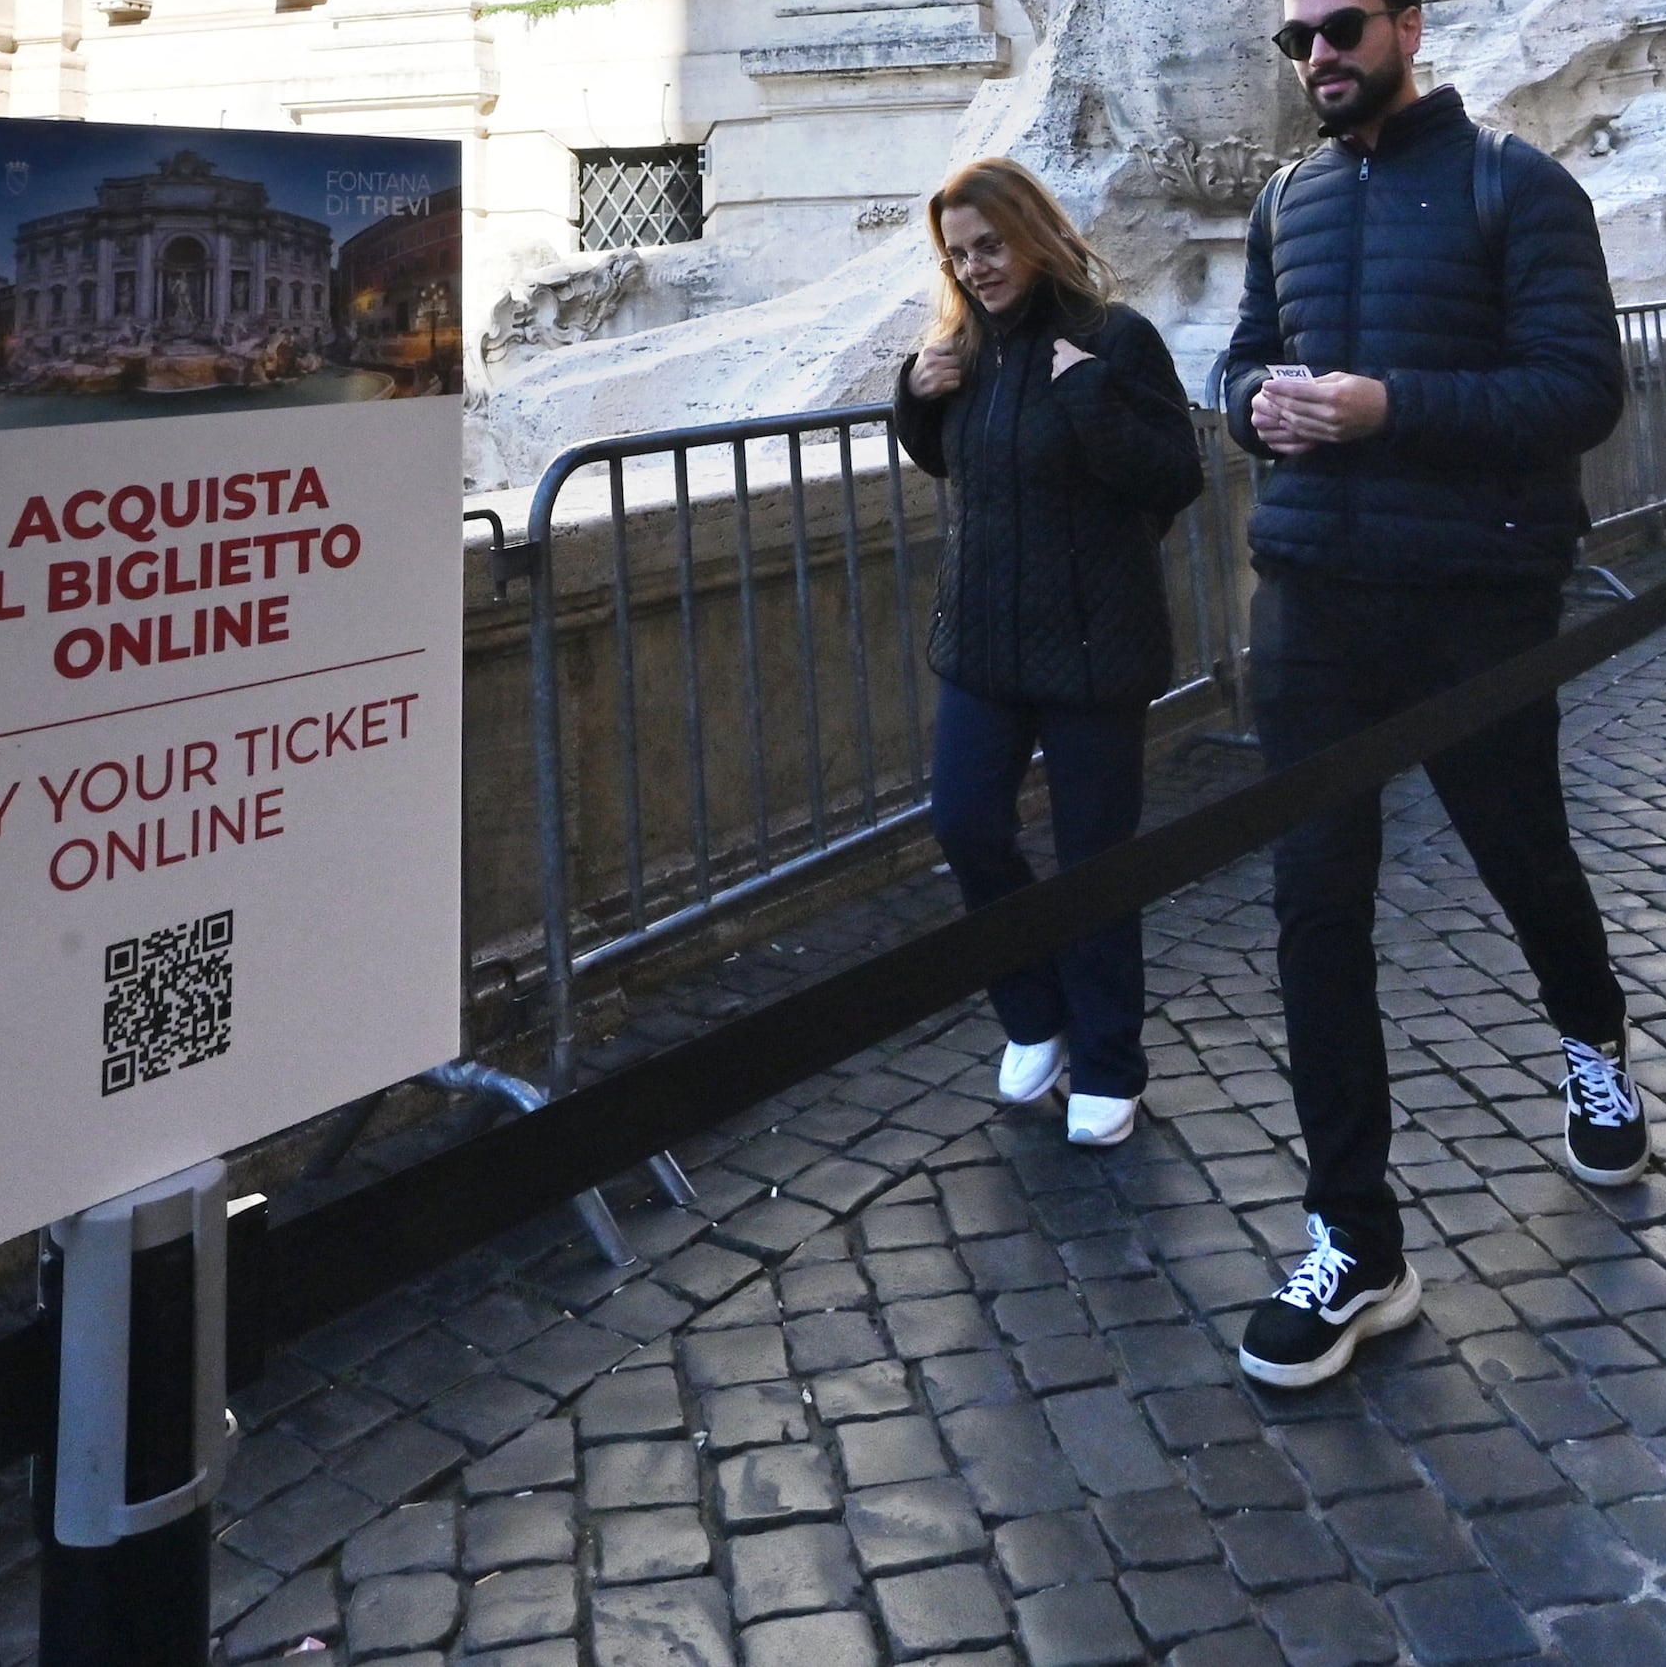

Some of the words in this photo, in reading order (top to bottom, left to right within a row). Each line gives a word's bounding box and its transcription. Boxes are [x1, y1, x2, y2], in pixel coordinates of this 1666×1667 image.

[326, 170, 431, 193] FONTANA
[326, 195, 350, 215] DI
[356, 196, 430, 216] TREVI
[1276, 369, 1307, 378] nexi
[8, 466, 329, 548] ACQUISTA
[47, 524, 361, 613] BIGLIETTO
[53, 596, 290, 679] ONLINE
[39, 741, 218, 823] YOUR
[235, 693, 419, 776] TICKET
[49, 788, 285, 891] ONLINE
